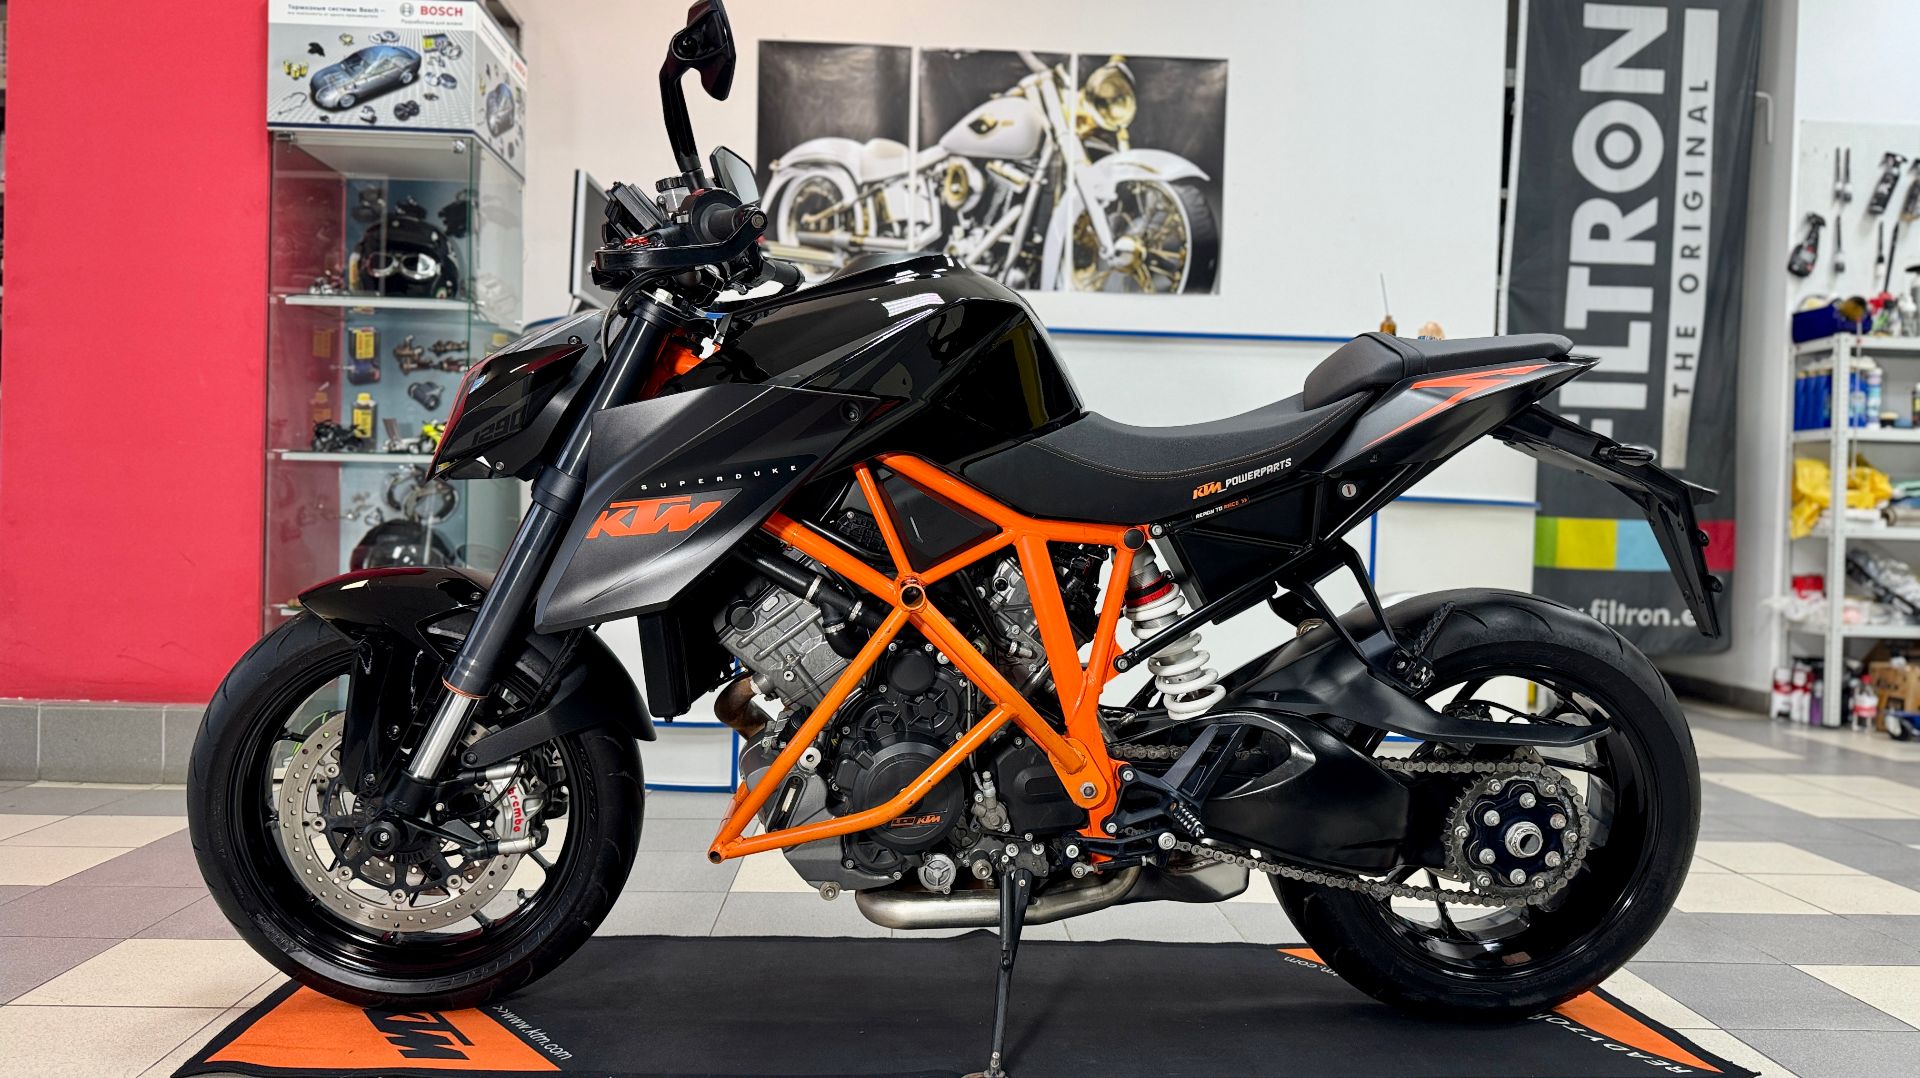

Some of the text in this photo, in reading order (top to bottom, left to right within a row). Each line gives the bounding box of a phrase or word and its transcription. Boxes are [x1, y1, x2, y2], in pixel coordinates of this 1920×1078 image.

[420, 6, 463, 16] BOSCH
[1558, 2, 1669, 439] ILTRON
[1673, 79, 1709, 398] THE ORIGINAL
[471, 406, 526, 446] 1290
[1192, 457, 1292, 500] KTM POWERPARTS
[586, 495, 721, 539] KTM
[1215, 505, 1223, 513] TO
[507, 784, 526, 833] brembo
[915, 814, 941, 825] KTM
